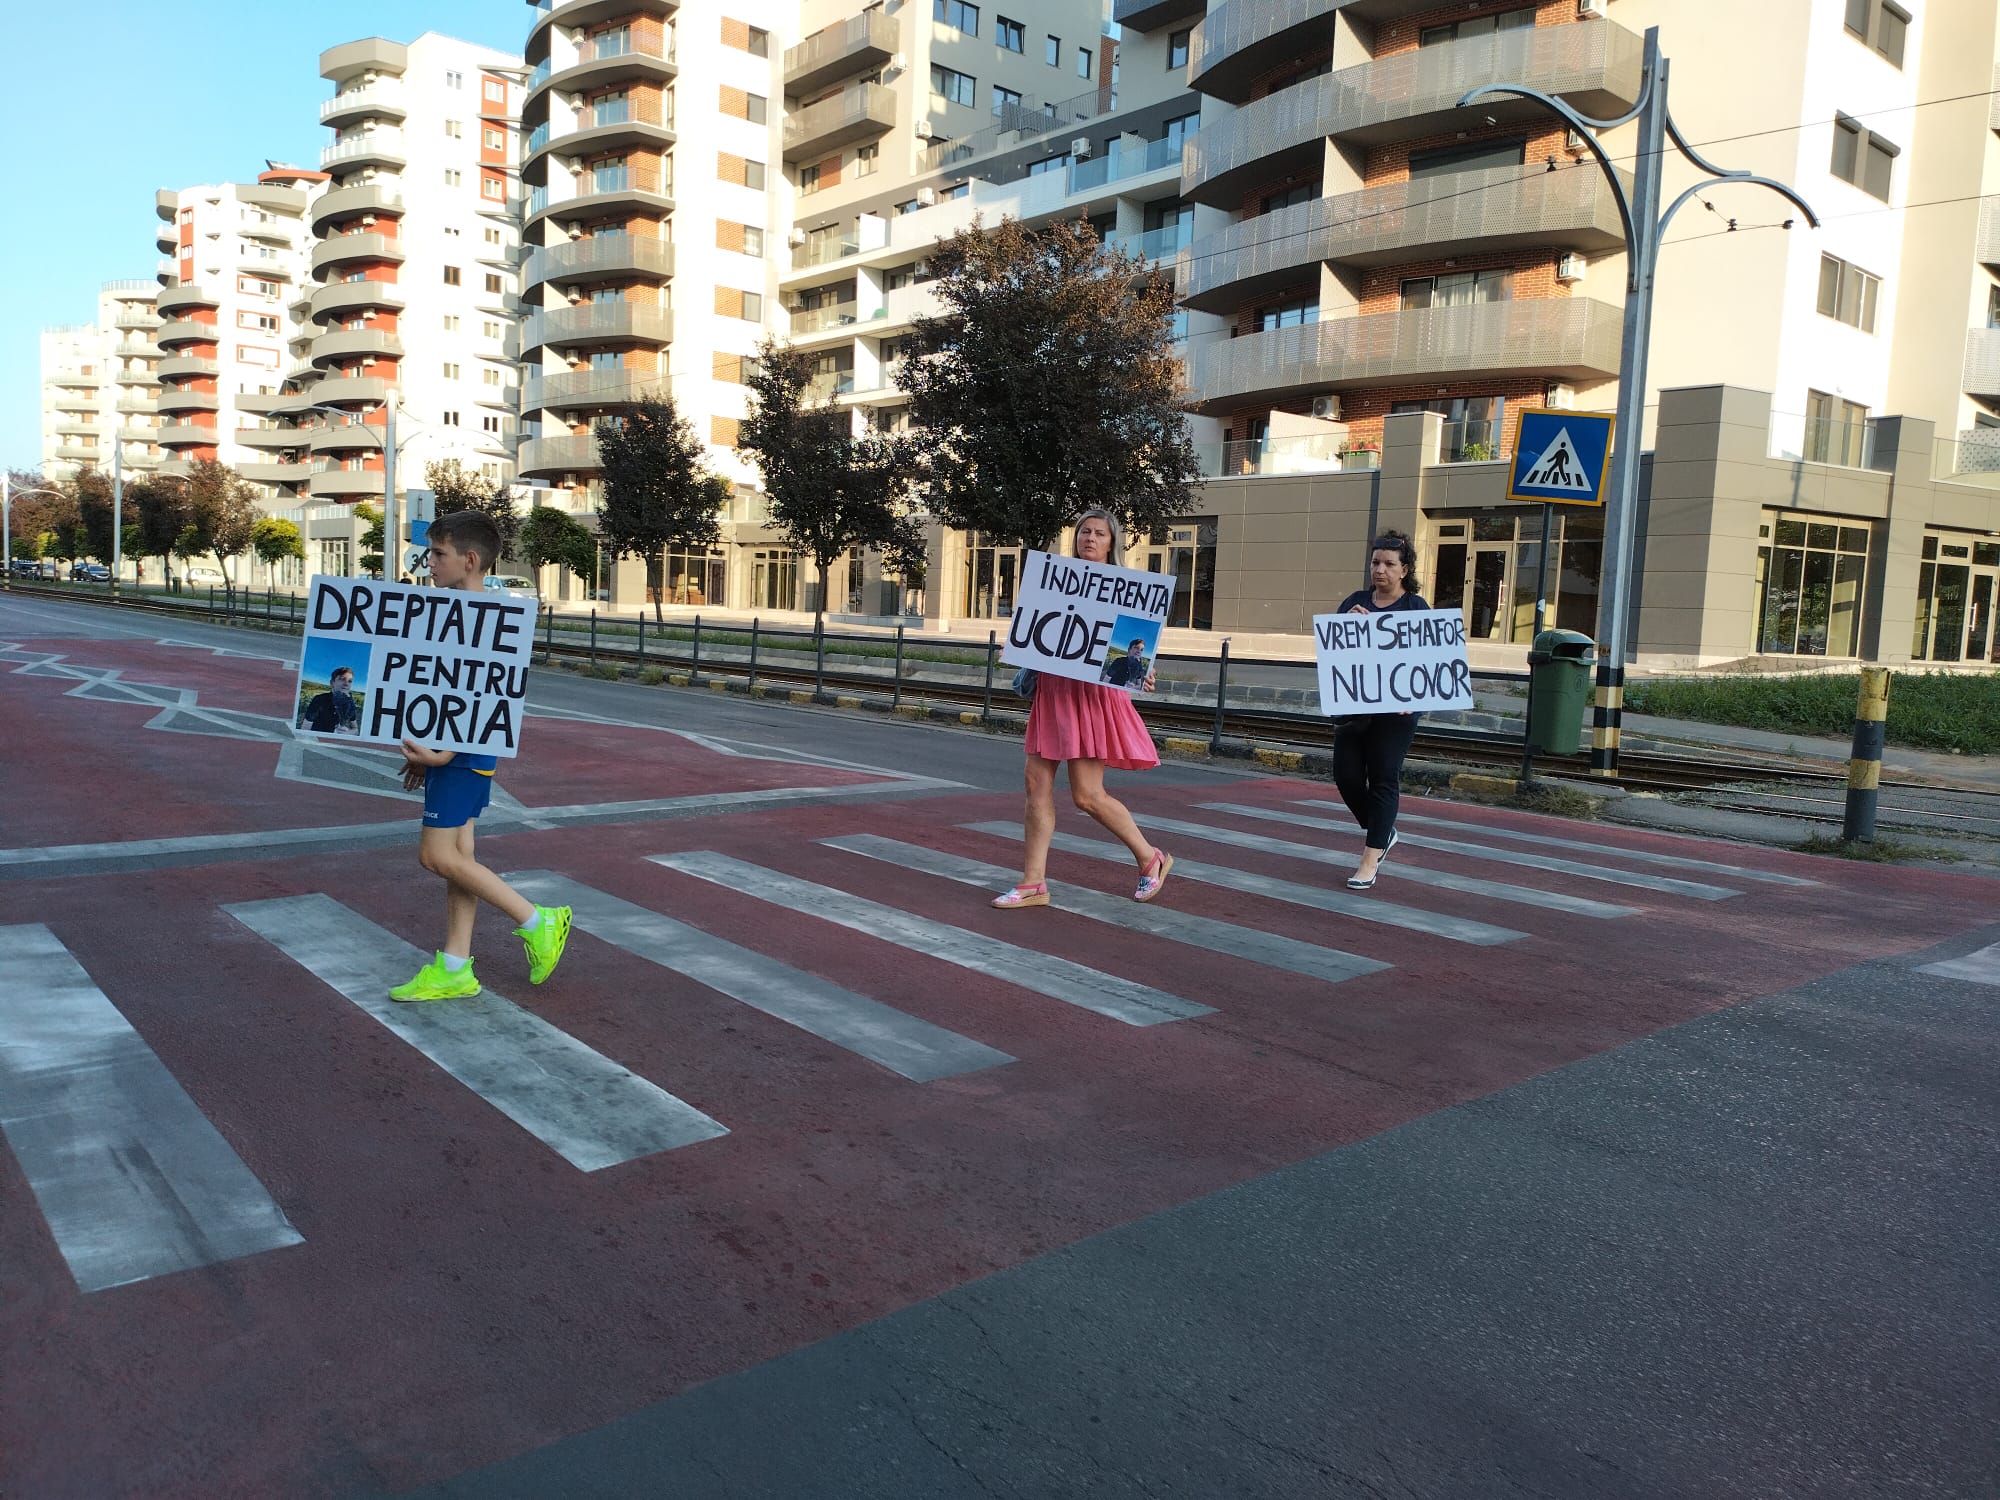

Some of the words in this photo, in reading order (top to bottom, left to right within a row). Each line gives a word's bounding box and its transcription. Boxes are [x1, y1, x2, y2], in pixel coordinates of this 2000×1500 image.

[313, 583, 525, 654] DREPTATE
[1315, 619, 1371, 651] VREM
[1376, 613, 1466, 650] SEMAFOR
[382, 652, 529, 699] PENTRU
[1332, 663, 1382, 704] NU
[1389, 658, 1472, 702] COVOR
